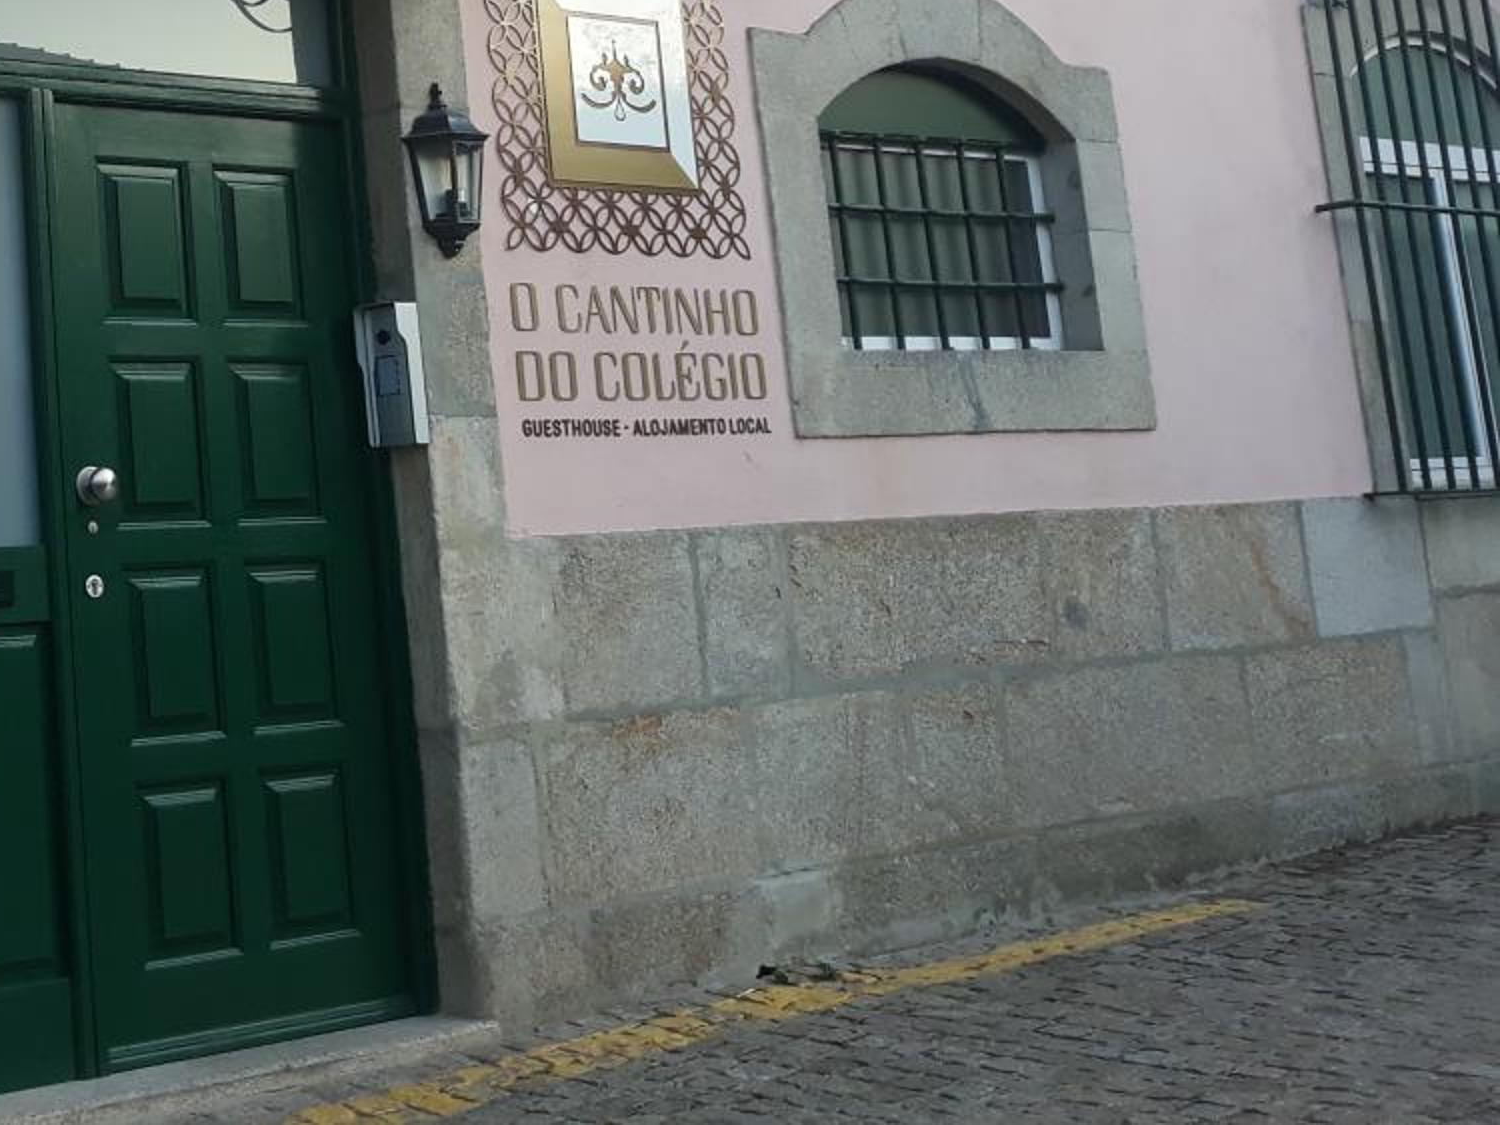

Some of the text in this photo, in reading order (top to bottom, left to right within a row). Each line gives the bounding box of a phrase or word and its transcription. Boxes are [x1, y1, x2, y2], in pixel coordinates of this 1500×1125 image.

[509, 282, 759, 336] O CANTINHO
[515, 340, 768, 402] DO COLÉGIO
[521, 418, 621, 437] GUESTHOUSE
[632, 417, 727, 437] ALOJAMENTO
[729, 416, 773, 435] LOCAL
